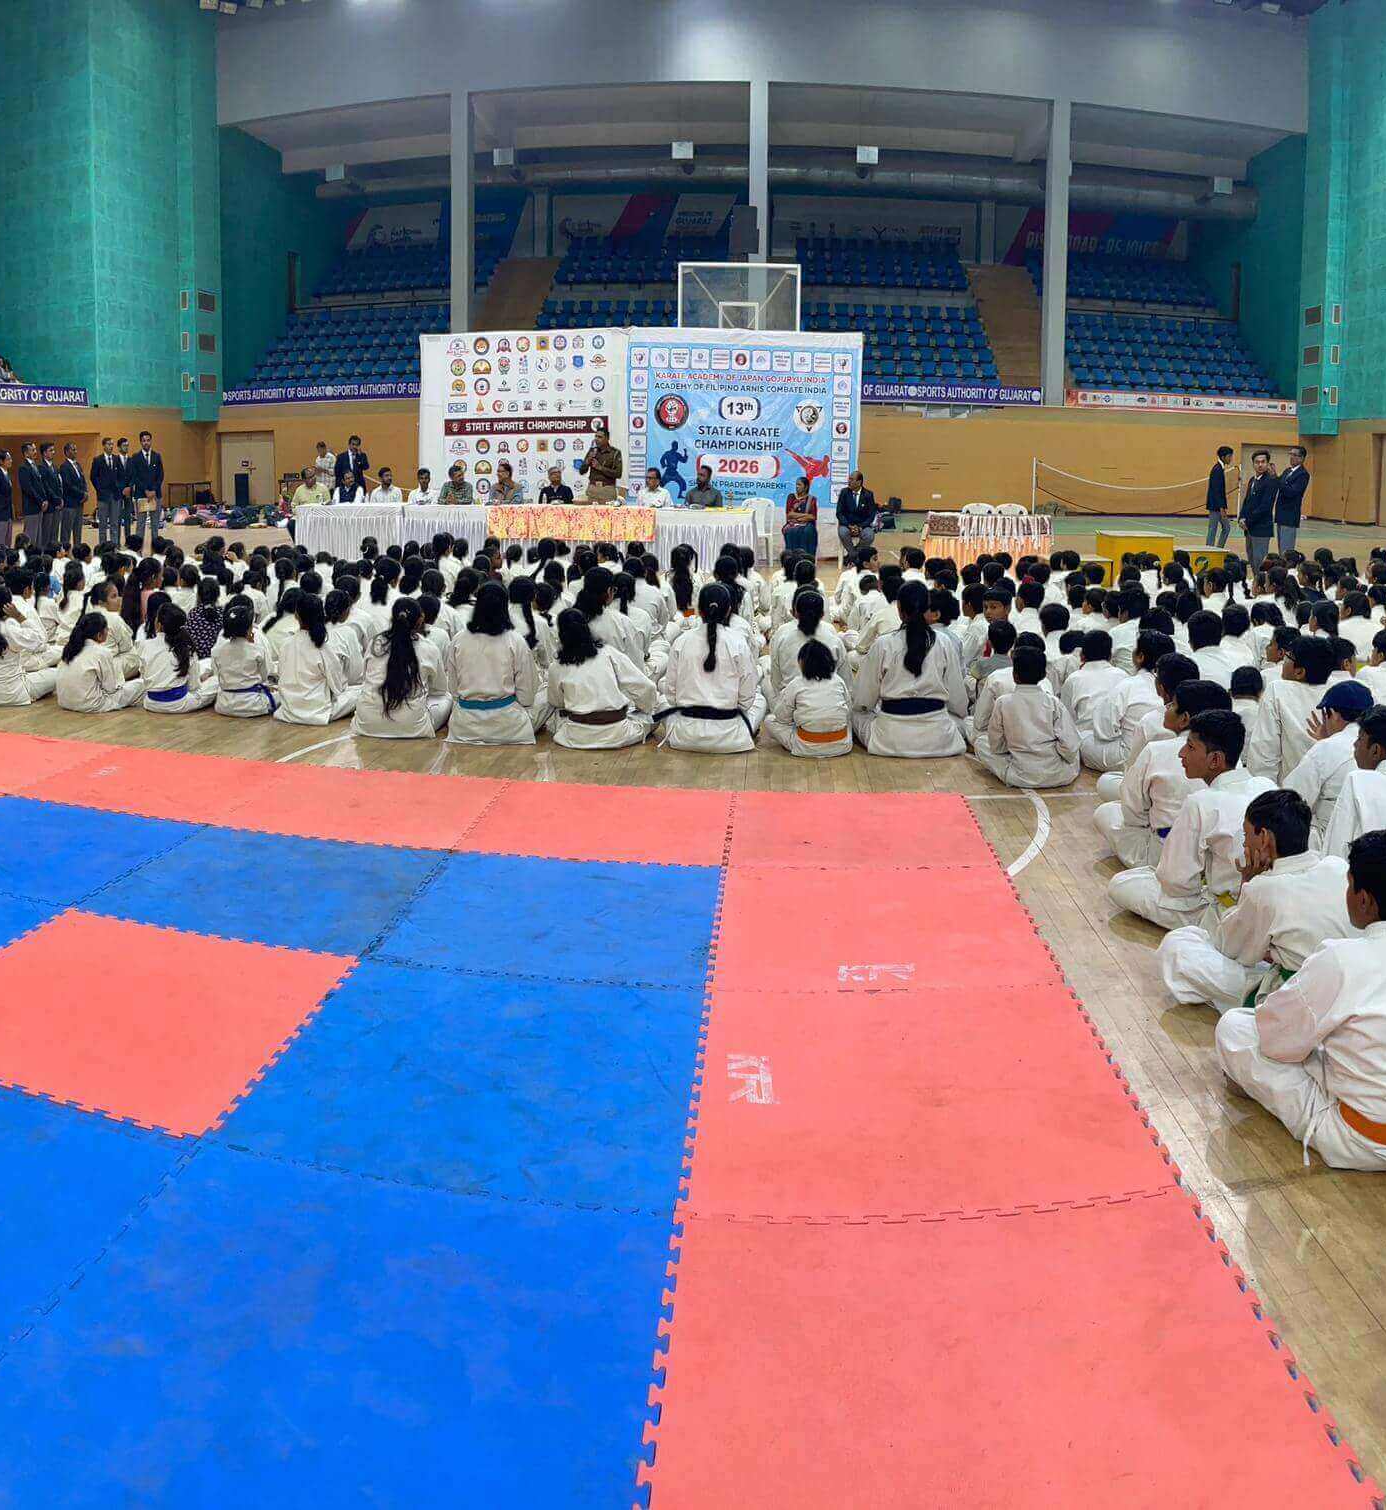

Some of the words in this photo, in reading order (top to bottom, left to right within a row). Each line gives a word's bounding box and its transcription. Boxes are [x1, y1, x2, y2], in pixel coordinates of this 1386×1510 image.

[655, 371, 685, 379] KARATE
[688, 373, 724, 381] ACADEMY
[226, 390, 251, 401] SPORTS
[251, 388, 286, 400] AUTHORITY
[287, 387, 296, 398] OF
[297, 386, 326, 398] GUJARAT
[333, 384, 359, 396] SPORTS
[360, 383, 396, 395] AUTHORITY
[398, 383, 407, 394] OF
[654, 383, 691, 391] ACADEMY
[705, 384, 739, 392] FILIPINO
[740, 385, 764, 393] ARNIS
[766, 386, 803, 394] COMBATE
[863, 384, 874, 395] OF
[875, 384, 908, 396] GUJARAT
[917, 386, 946, 398] SPORTS
[947, 387, 988, 399] AUTHORITY
[989, 388, 999, 399] OF
[999, 389, 1032, 401] GUJARAT
[30, 389, 44, 402] OF
[46, 390, 85, 403] GUJARAT
[727, 401, 754, 416] 13th
[465, 420, 491, 432] STATE
[493, 420, 524, 431] KARATE
[527, 419, 587, 430] CHAMPIONSHIP
[698, 425, 732, 436] STATE
[735, 427, 780, 437] KARATE
[694, 440, 783, 451] CHAMPIONSHIP
[718, 459, 759, 474] 2026
[719, 480, 755, 489] PRADEEP
